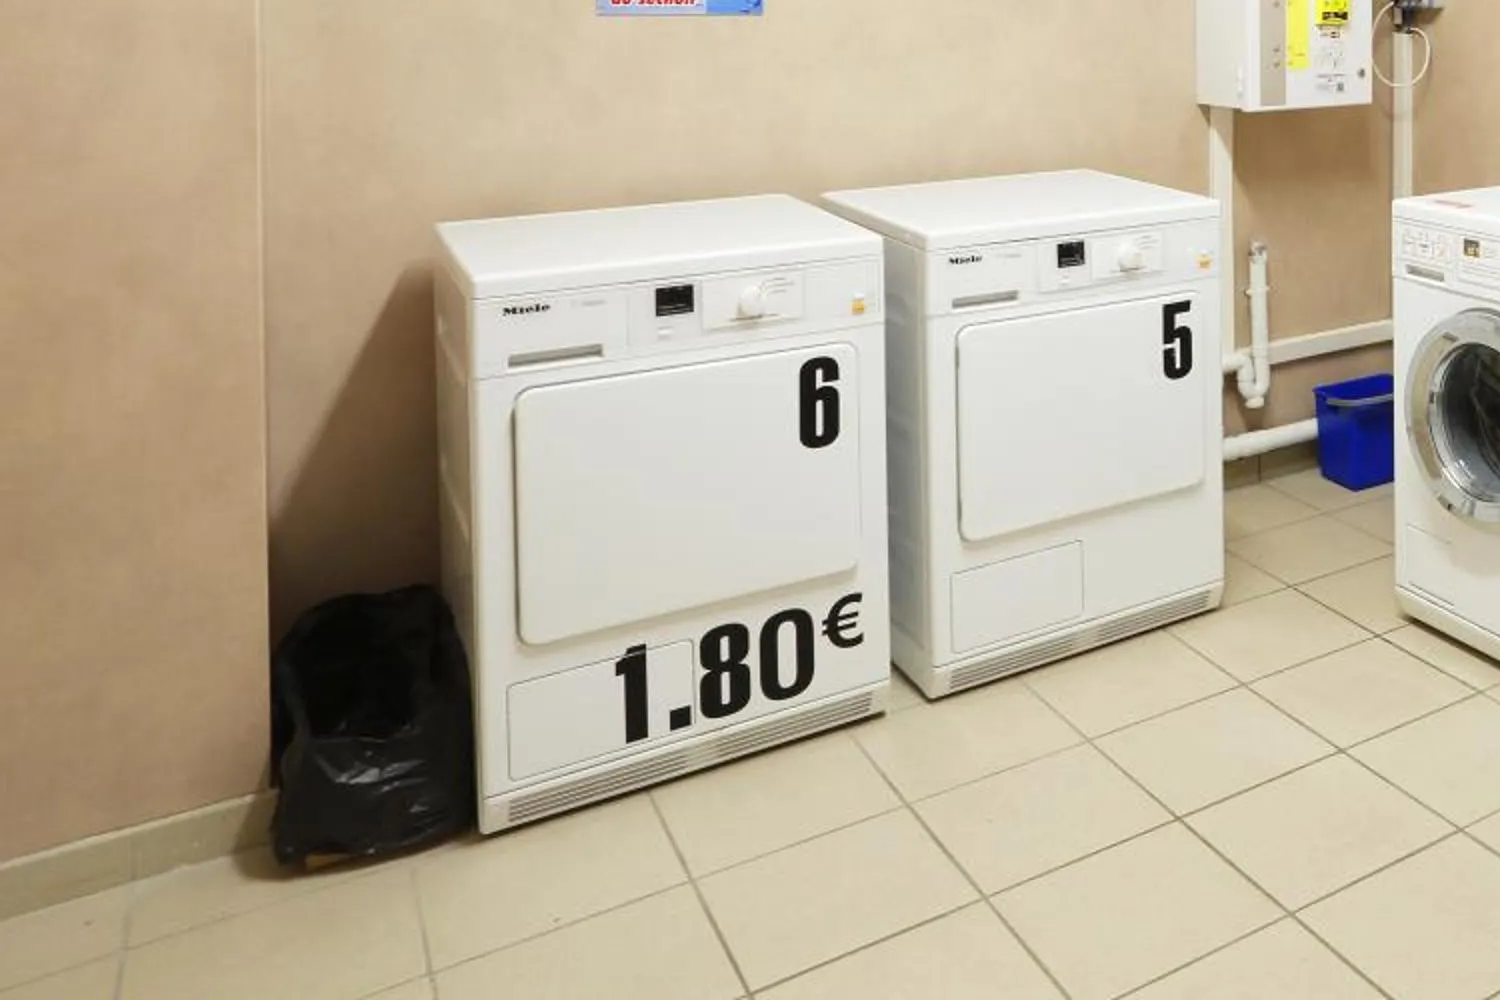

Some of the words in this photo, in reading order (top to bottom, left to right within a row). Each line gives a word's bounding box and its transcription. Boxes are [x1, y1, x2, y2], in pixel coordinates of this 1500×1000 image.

[949, 254, 983, 266] Miele
[502, 302, 551, 317] Miele
[1162, 299, 1193, 380] 5
[799, 355, 841, 449] 6
[615, 592, 864, 745] 1.80€
